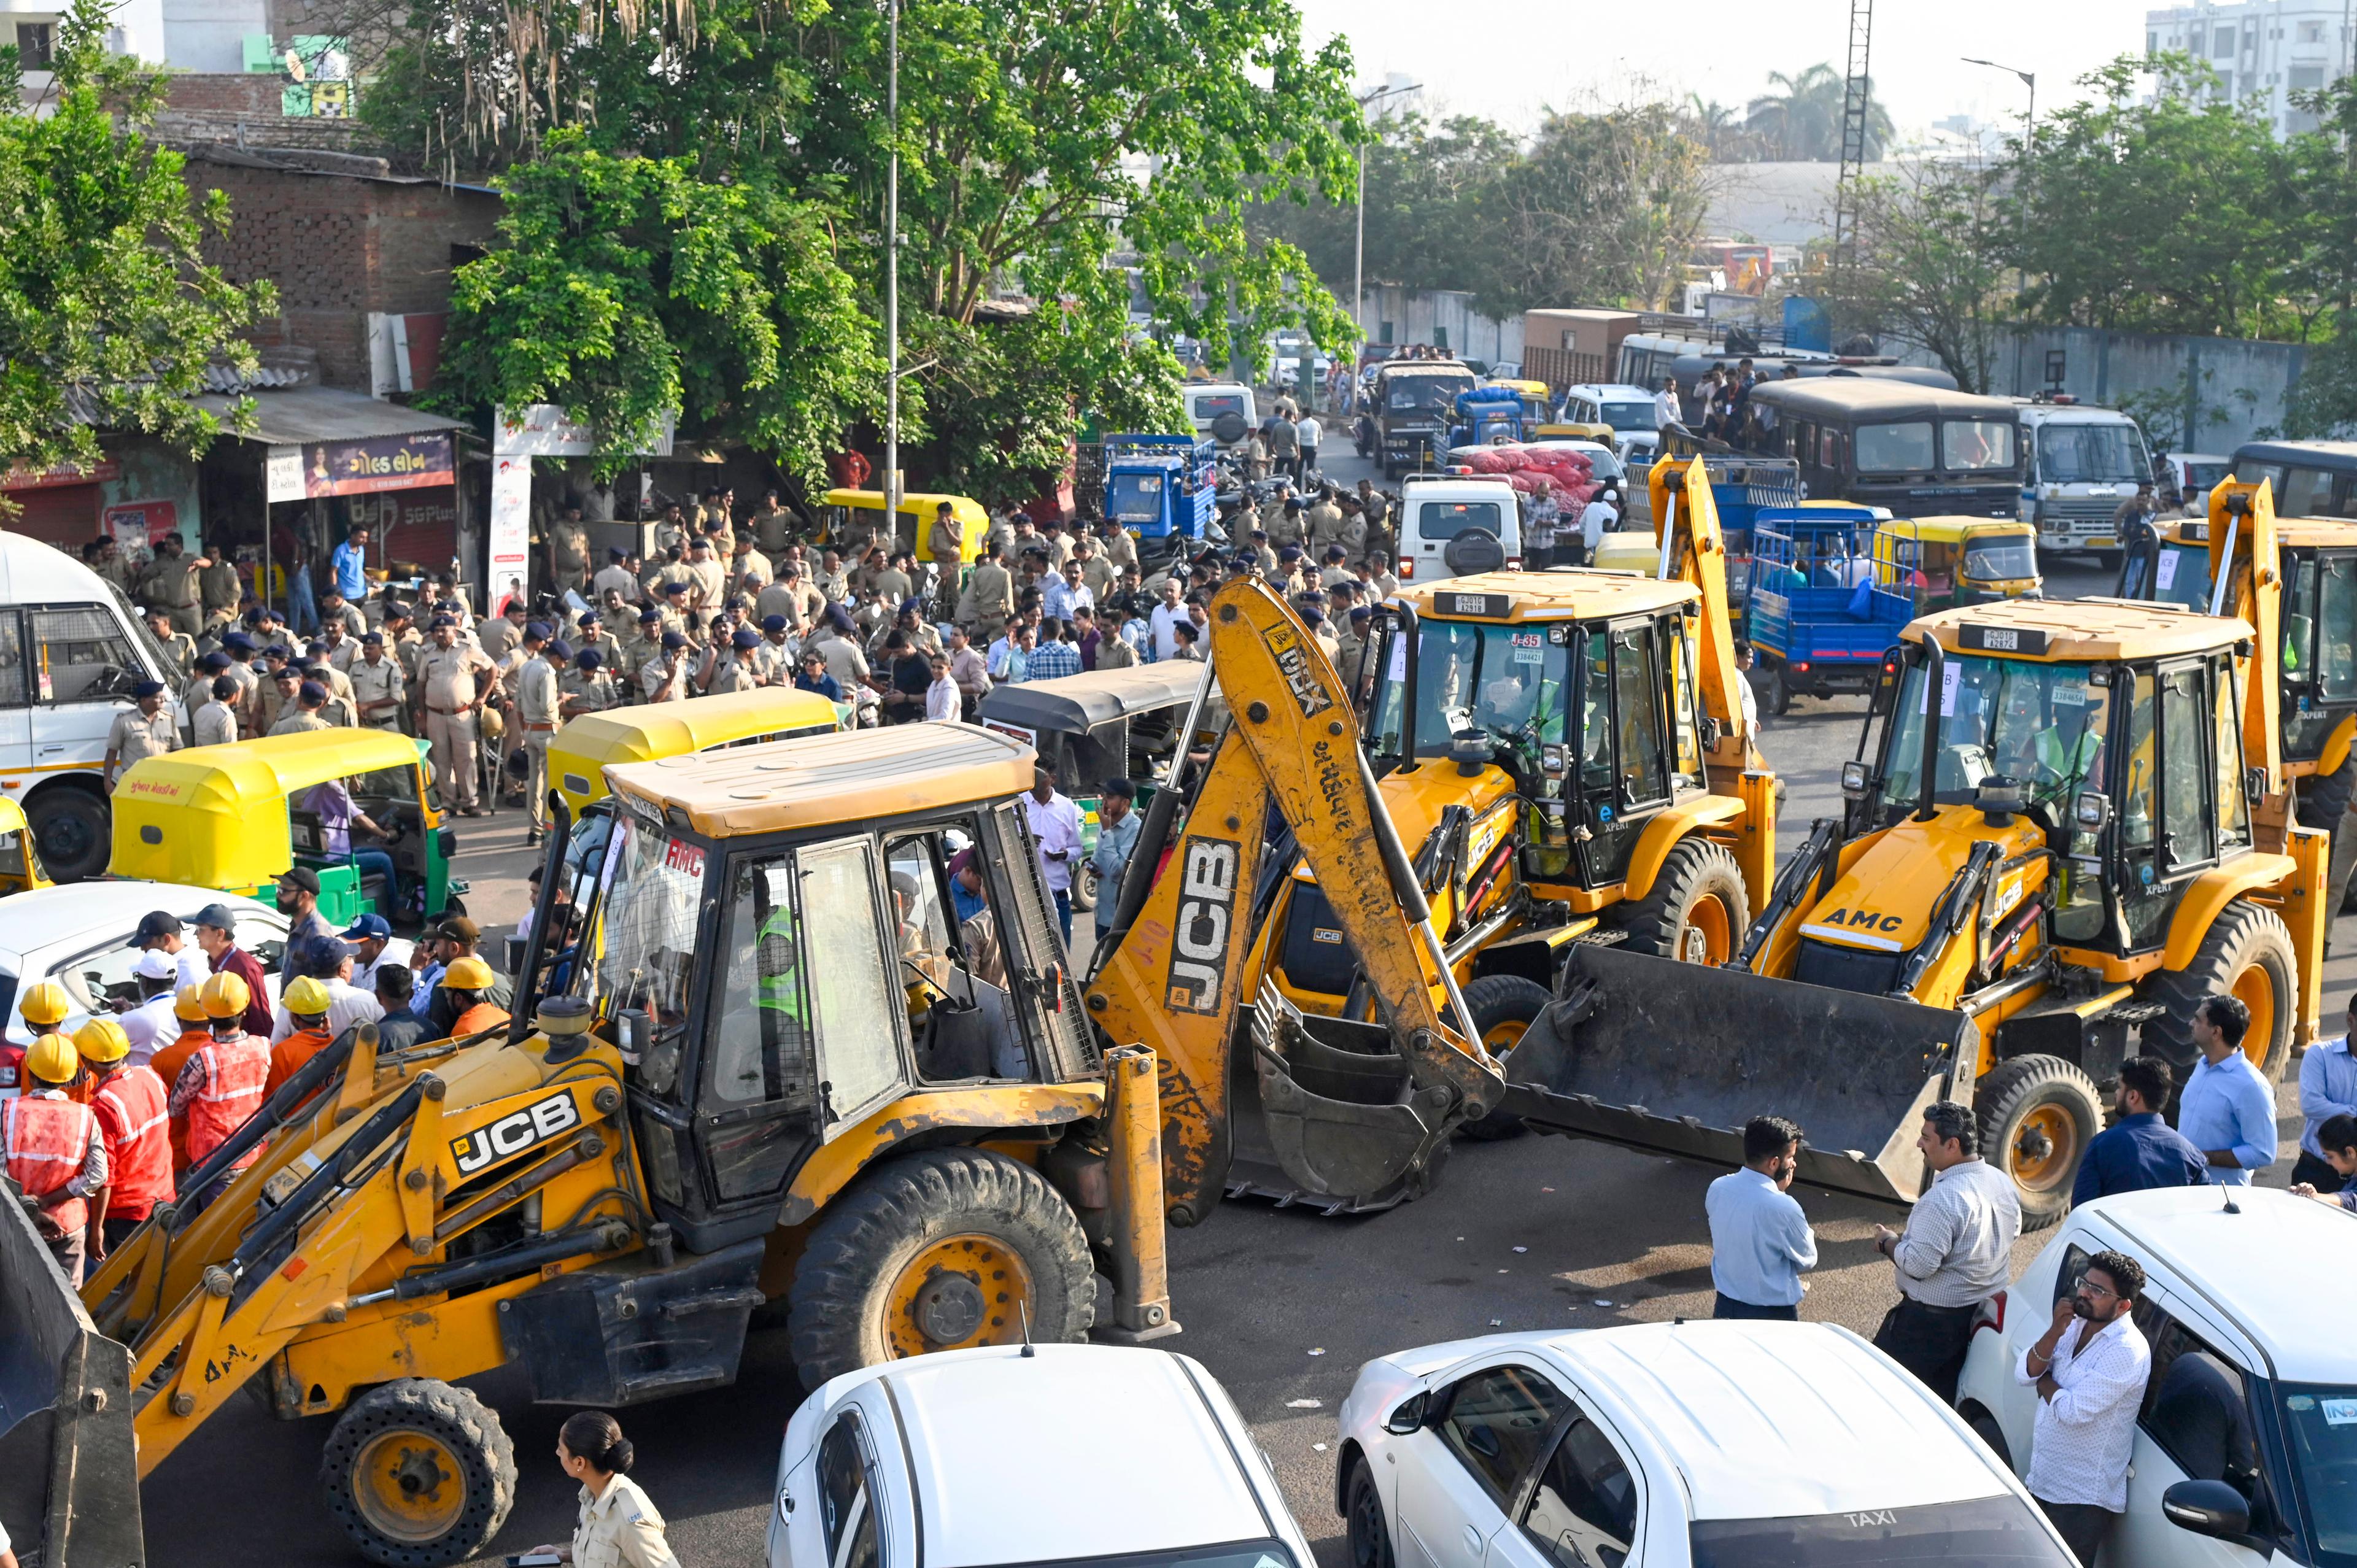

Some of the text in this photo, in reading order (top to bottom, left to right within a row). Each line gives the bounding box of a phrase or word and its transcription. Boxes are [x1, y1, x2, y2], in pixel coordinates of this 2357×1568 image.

[349, 447, 426, 475] ગોલ્ડ લોન
[404, 505, 455, 525] 5GPlus
[1460, 595, 1482, 604] GJ01G
[1460, 604, 1482, 612] A2918
[1512, 634, 1538, 647] J-35
[1516, 653, 1541, 662] 3384421
[2054, 692, 2084, 703] 3384656
[1604, 822, 1629, 833] XPERT
[1468, 827, 1495, 870] JCB
[665, 838, 705, 878] AMC
[1994, 879, 2024, 919] JCB
[2145, 884, 2172, 897] XPERT
[1173, 841, 1236, 1011] JCB
[1822, 908, 1903, 932] AMC
[1315, 930, 1341, 941] JCB
[458, 1094, 577, 1172] JCB
[1843, 1510, 1898, 1528] TAXI
